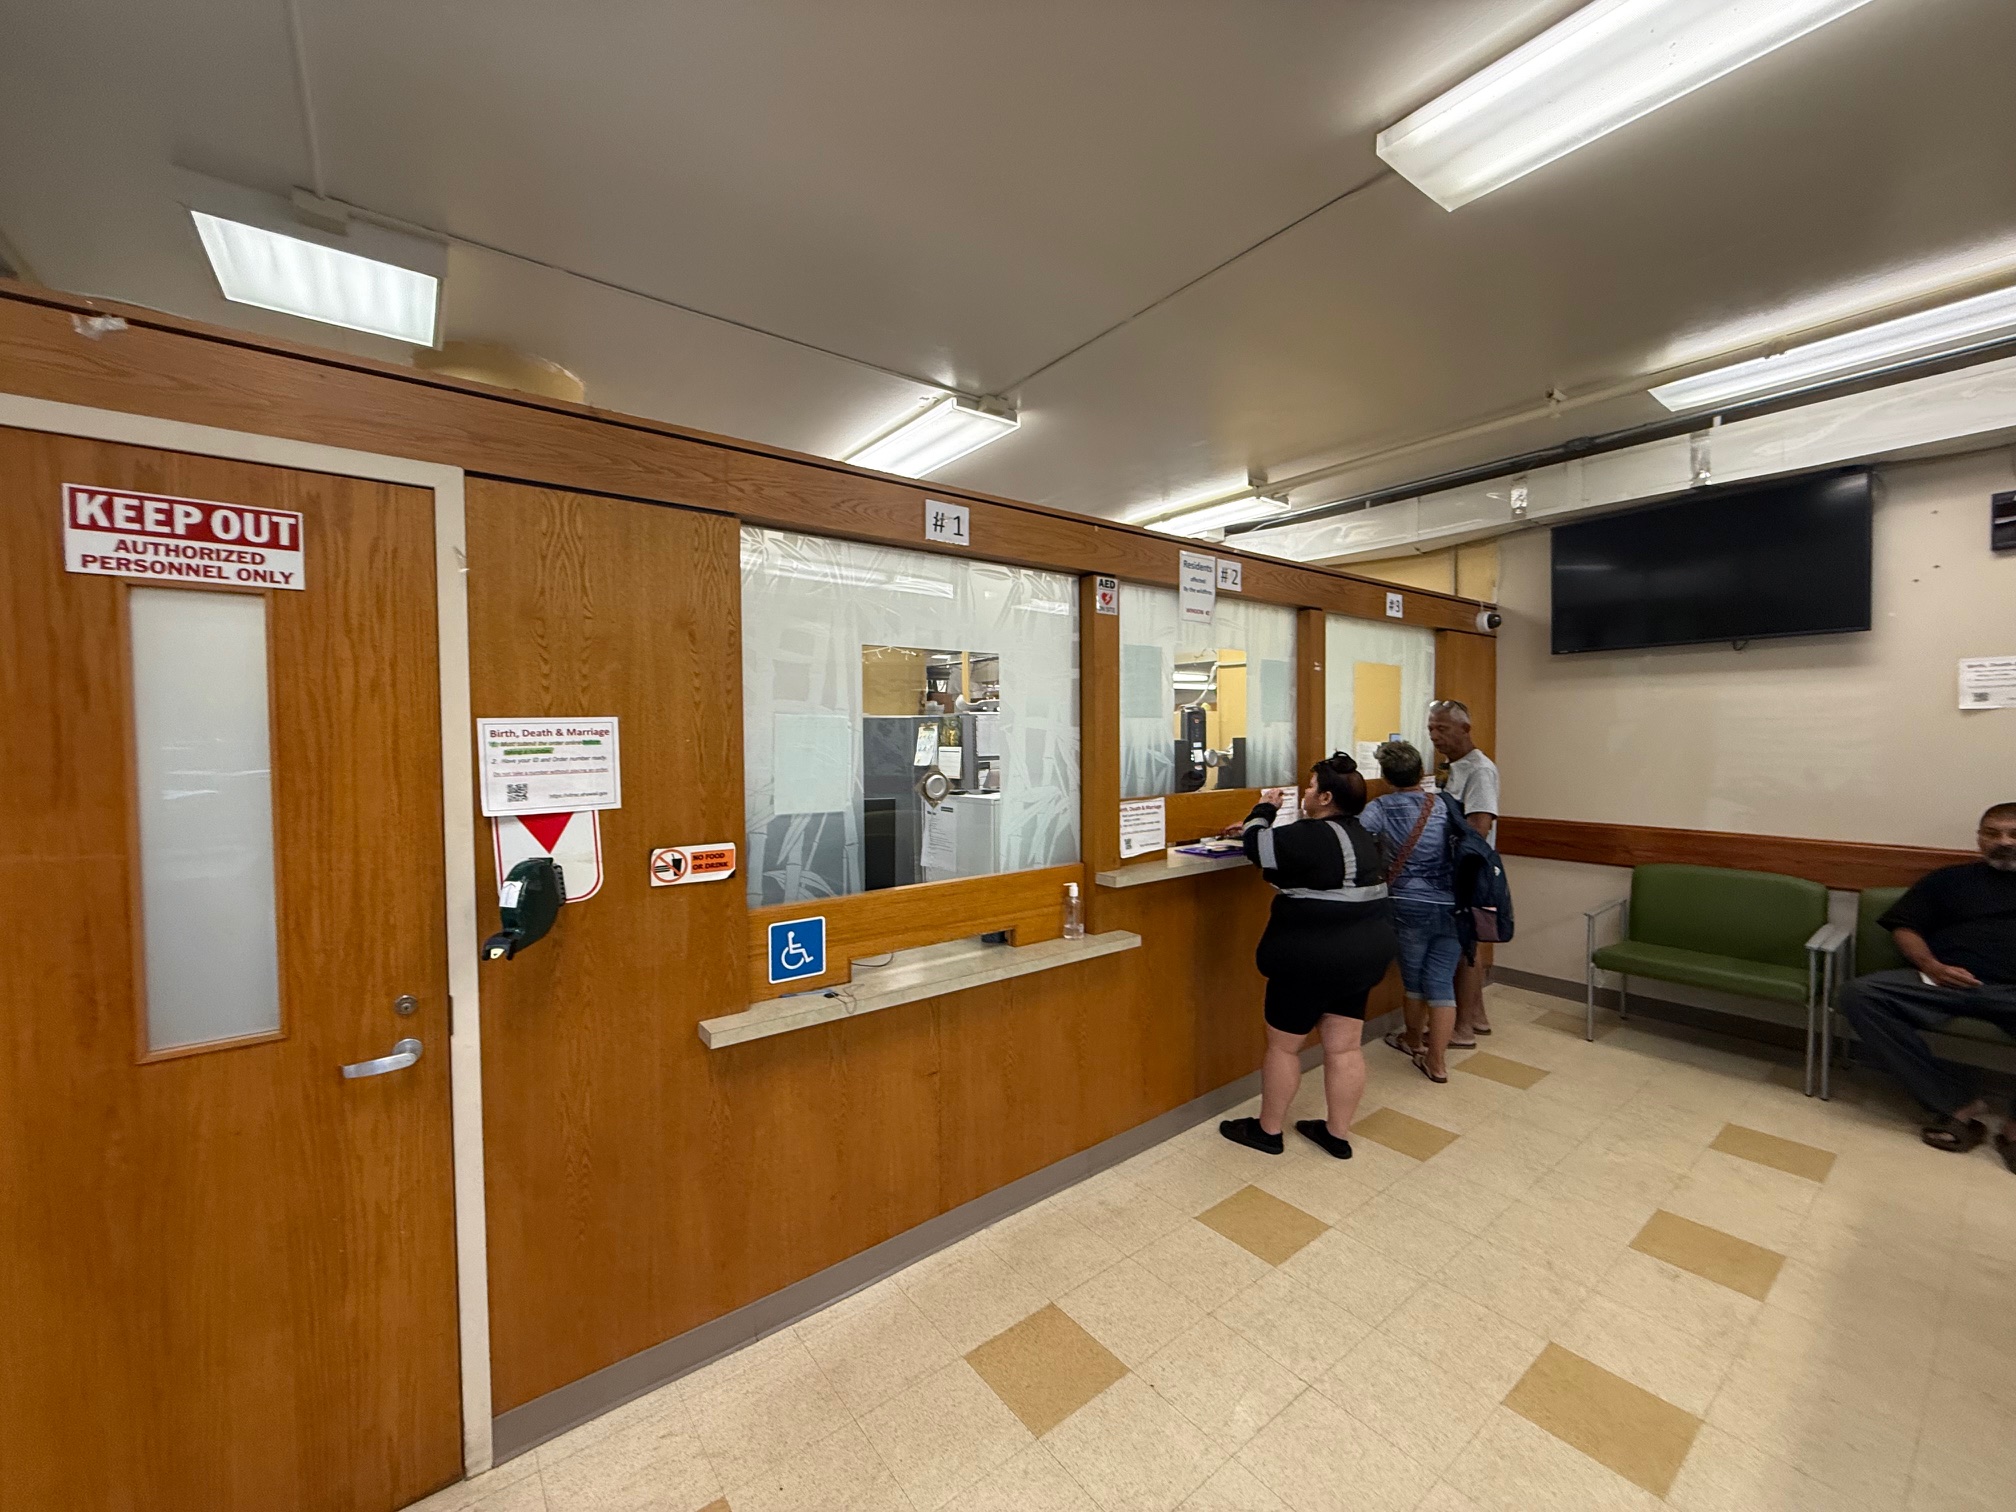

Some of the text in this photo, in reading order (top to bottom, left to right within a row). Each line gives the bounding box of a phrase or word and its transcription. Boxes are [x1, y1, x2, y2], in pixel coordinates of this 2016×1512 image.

[75, 491, 297, 546] KEEP OUT
[113, 538, 266, 565] AUTHORIZED
[81, 553, 294, 585] PERSONNEL ONLY
[1183, 560, 1213, 573] Residents
[1220, 566, 1239, 586] #2
[1098, 578, 1116, 590] AED
[490, 728, 610, 739] Birth, Death & Marriage
[693, 852, 725, 861] NO FOOD
[705, 861, 728, 869] DRINK
